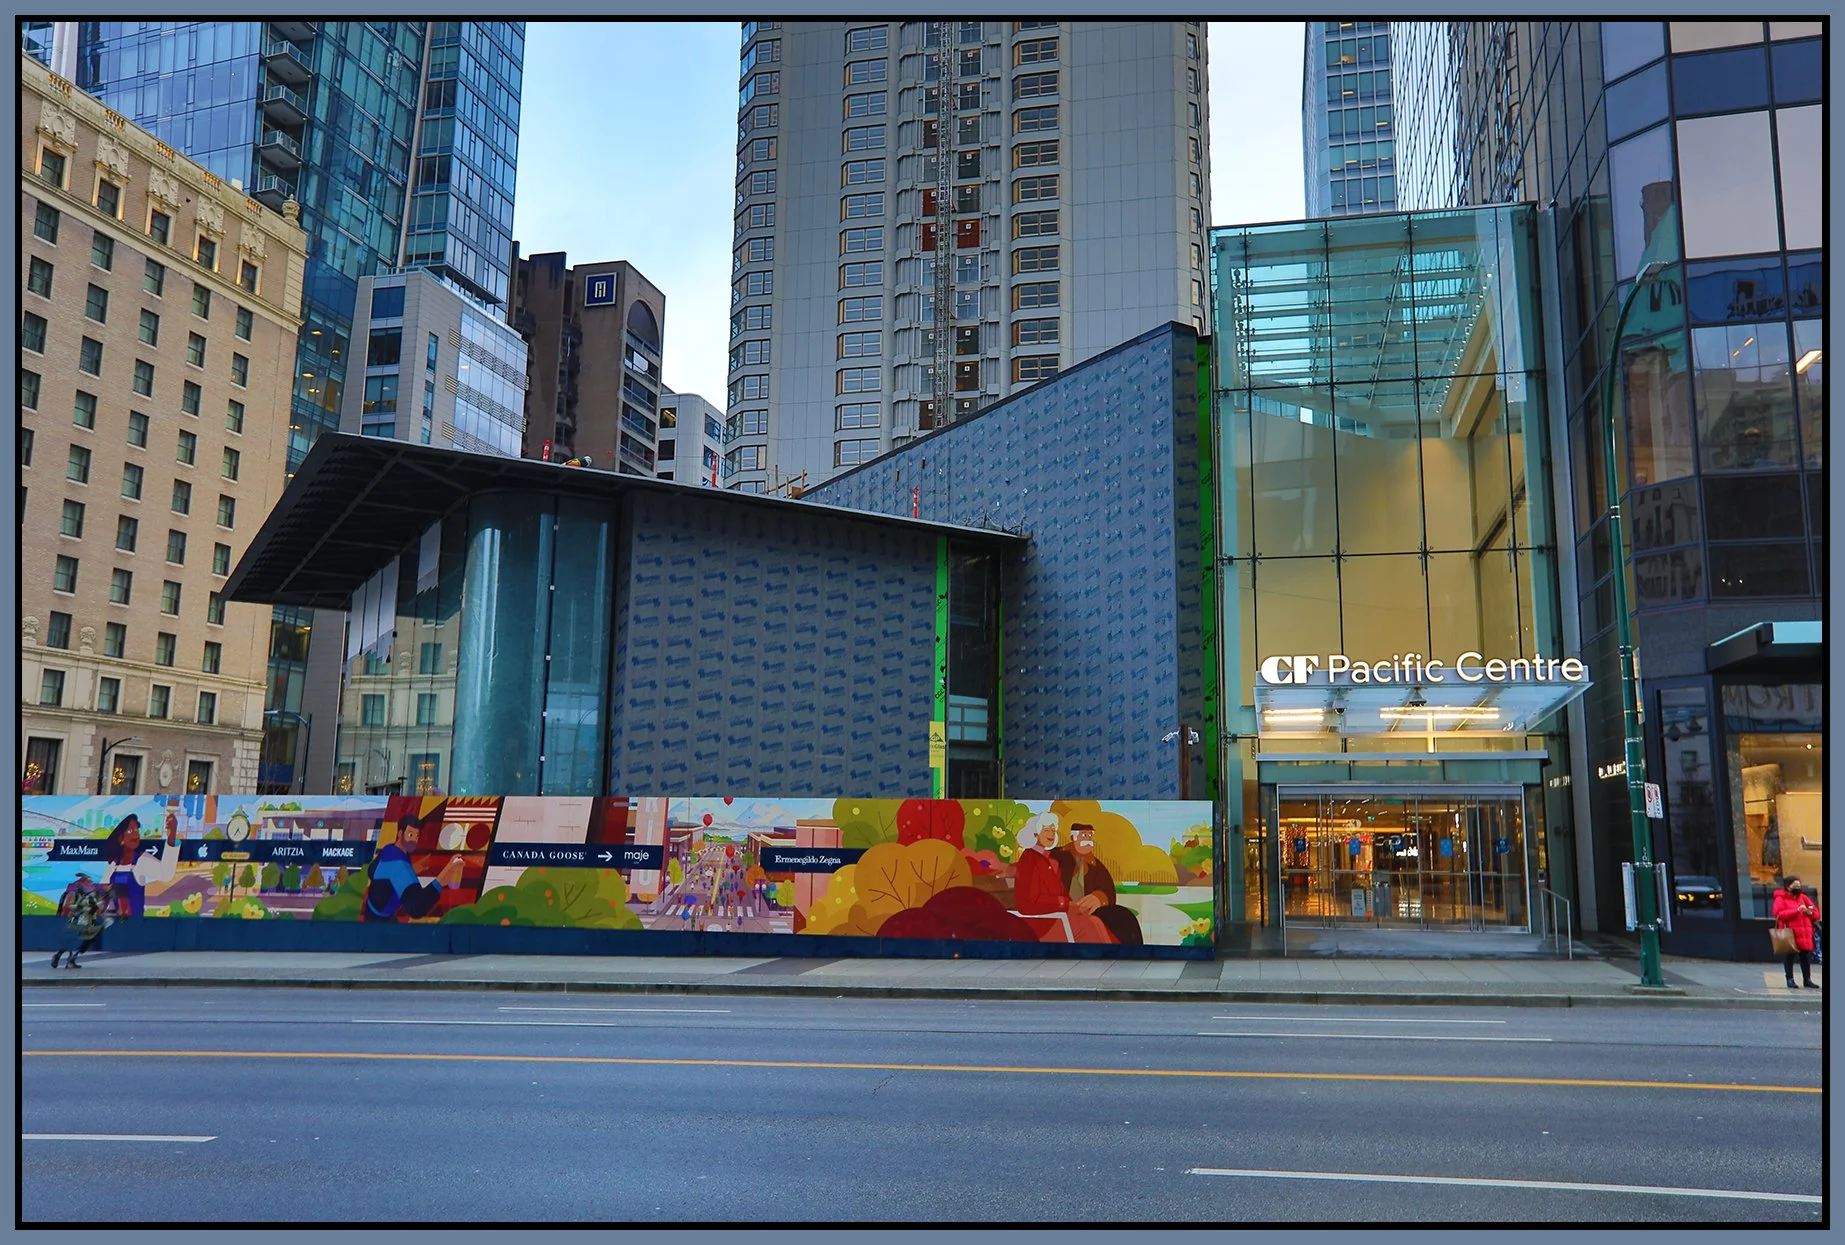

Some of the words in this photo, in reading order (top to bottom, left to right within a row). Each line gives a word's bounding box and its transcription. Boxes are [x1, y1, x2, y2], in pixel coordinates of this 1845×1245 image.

[1261, 655, 1319, 684] CF
[1328, 653, 1445, 685] Pacific
[1456, 651, 1585, 683] Centre
[60, 845, 98, 855] MaxMara
[272, 847, 304, 857] ARITZIA
[322, 847, 354, 857] MACKAGE
[502, 850, 545, 860] CANADA
[549, 851, 585, 860] GOOSE
[624, 849, 649, 861] maje
[775, 855, 818, 866] Ermenegildo
[819, 855, 841, 867] Zegna
